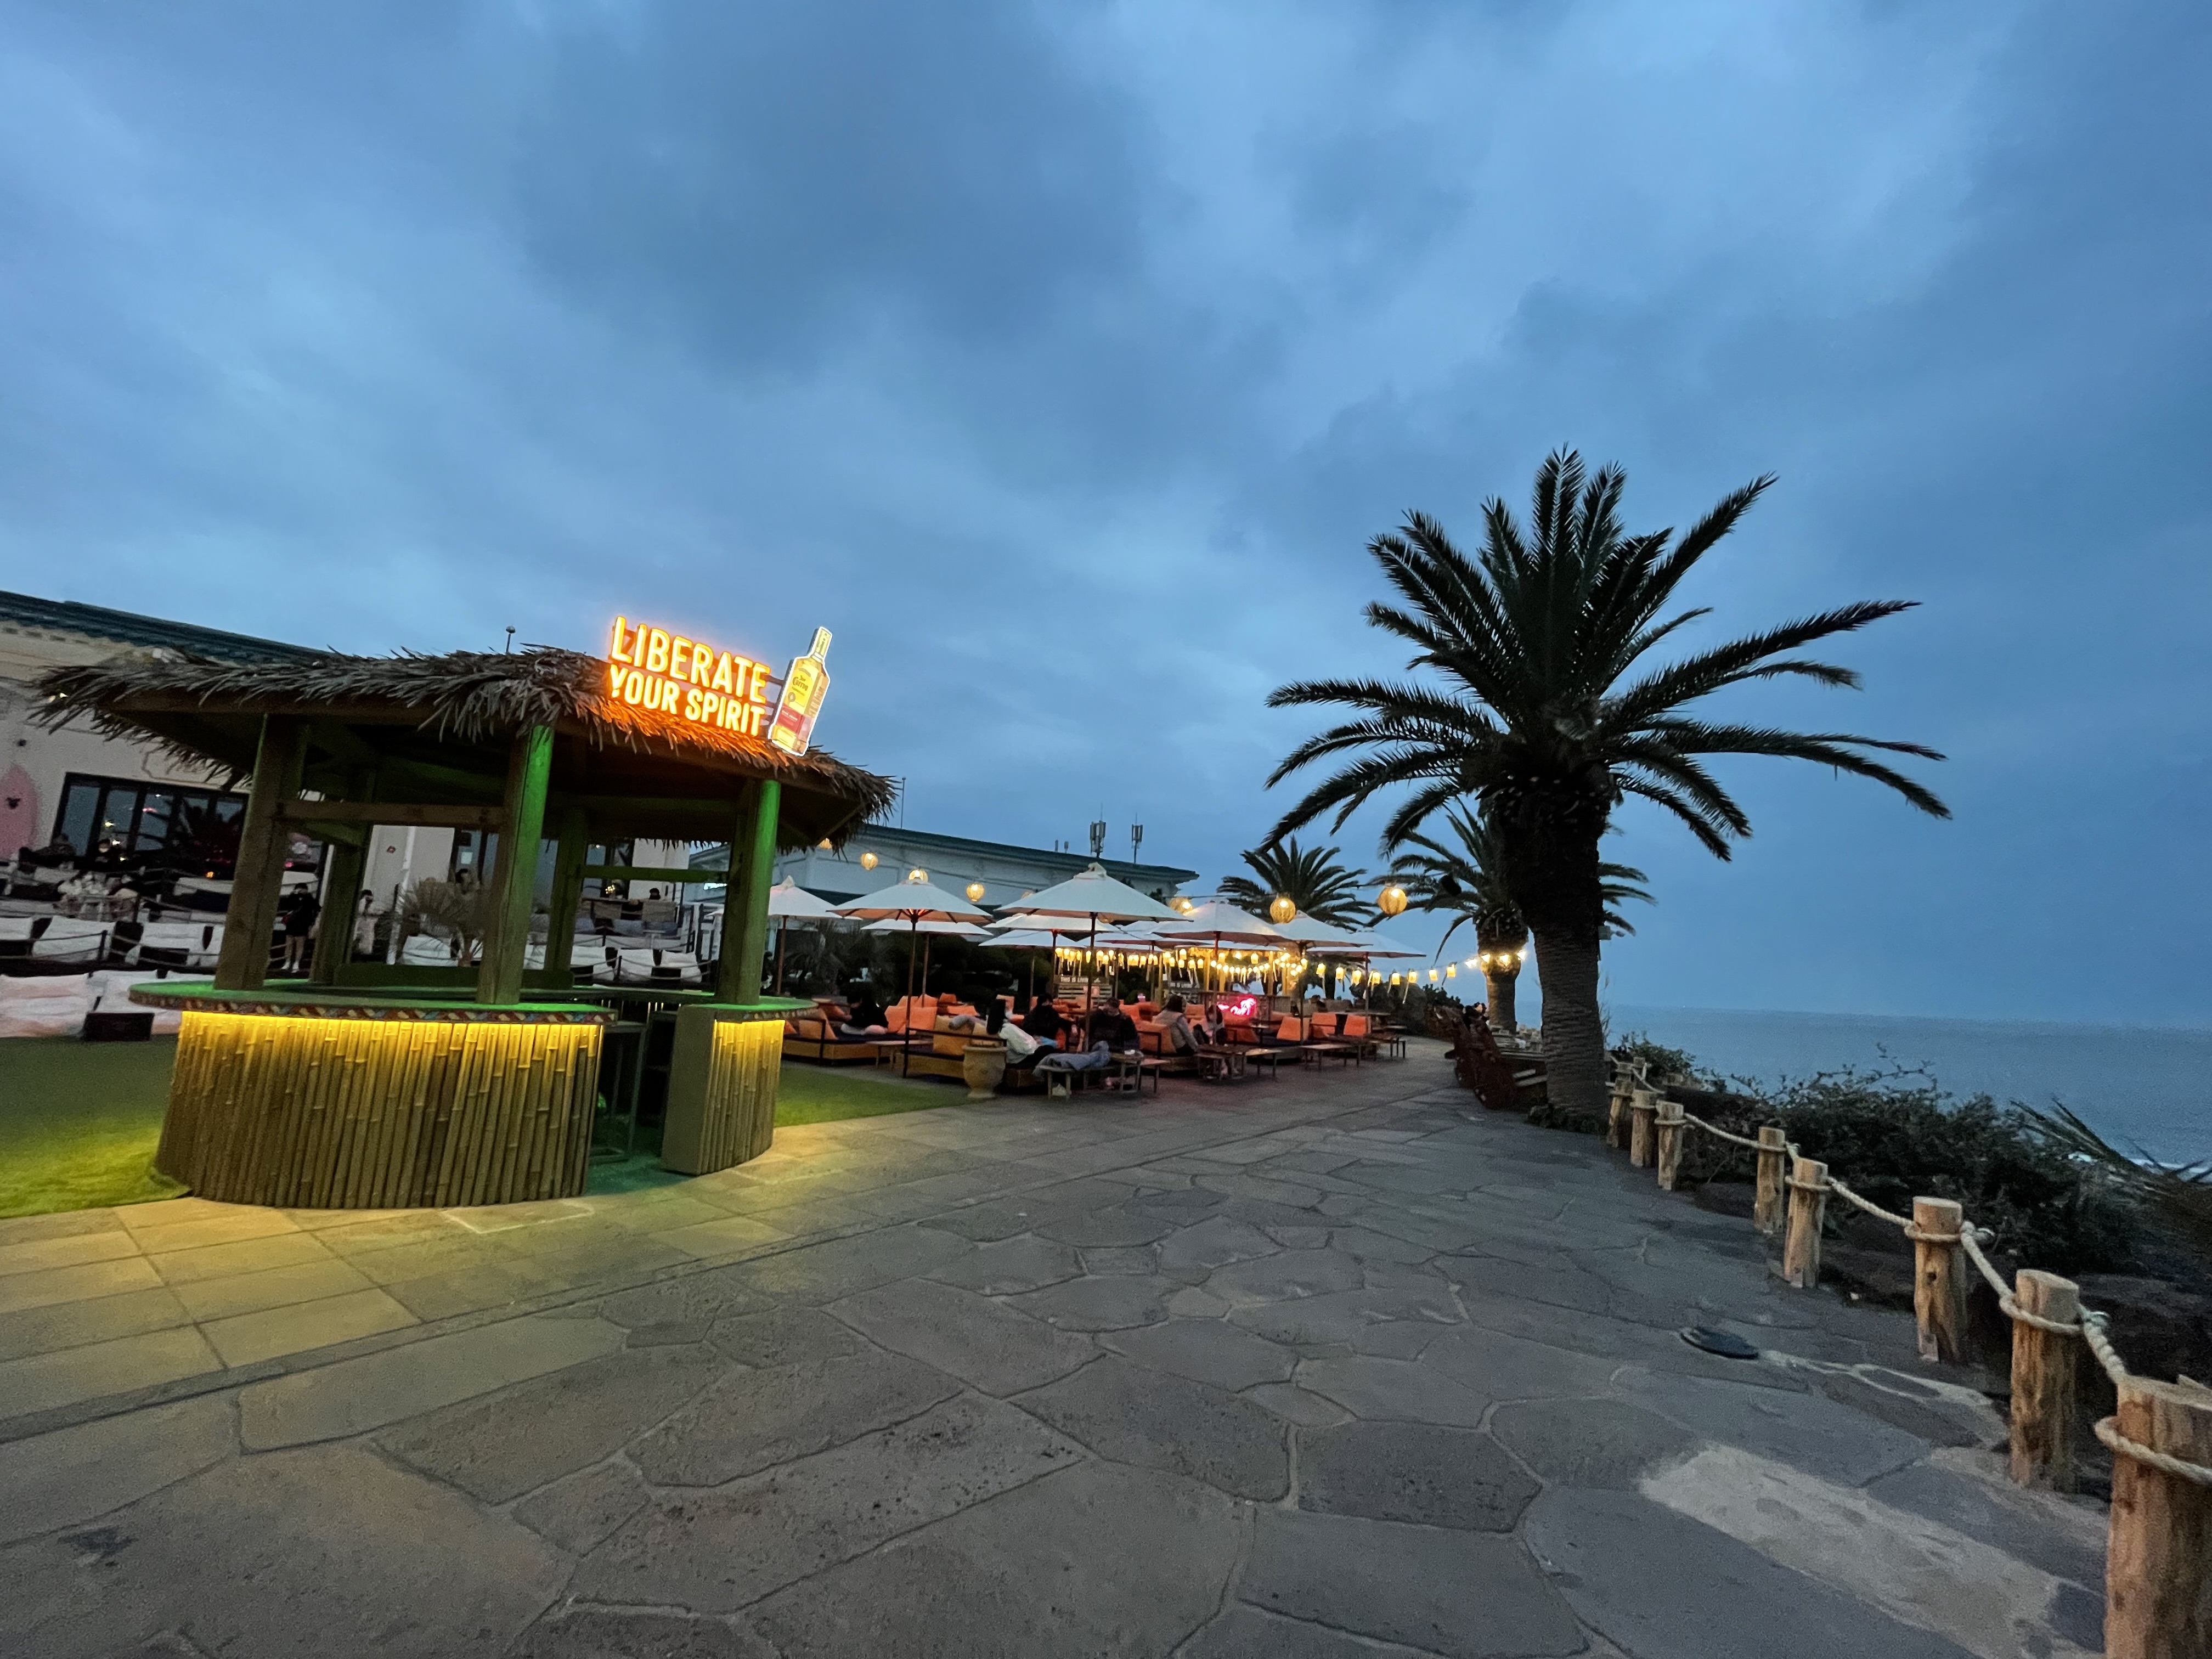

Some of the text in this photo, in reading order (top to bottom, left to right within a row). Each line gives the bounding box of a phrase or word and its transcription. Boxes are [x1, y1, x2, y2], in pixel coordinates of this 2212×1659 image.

[611, 616, 771, 704] LIBERATE
[610, 664, 681, 715] YOUR
[685, 688, 766, 737] SPIRIT
